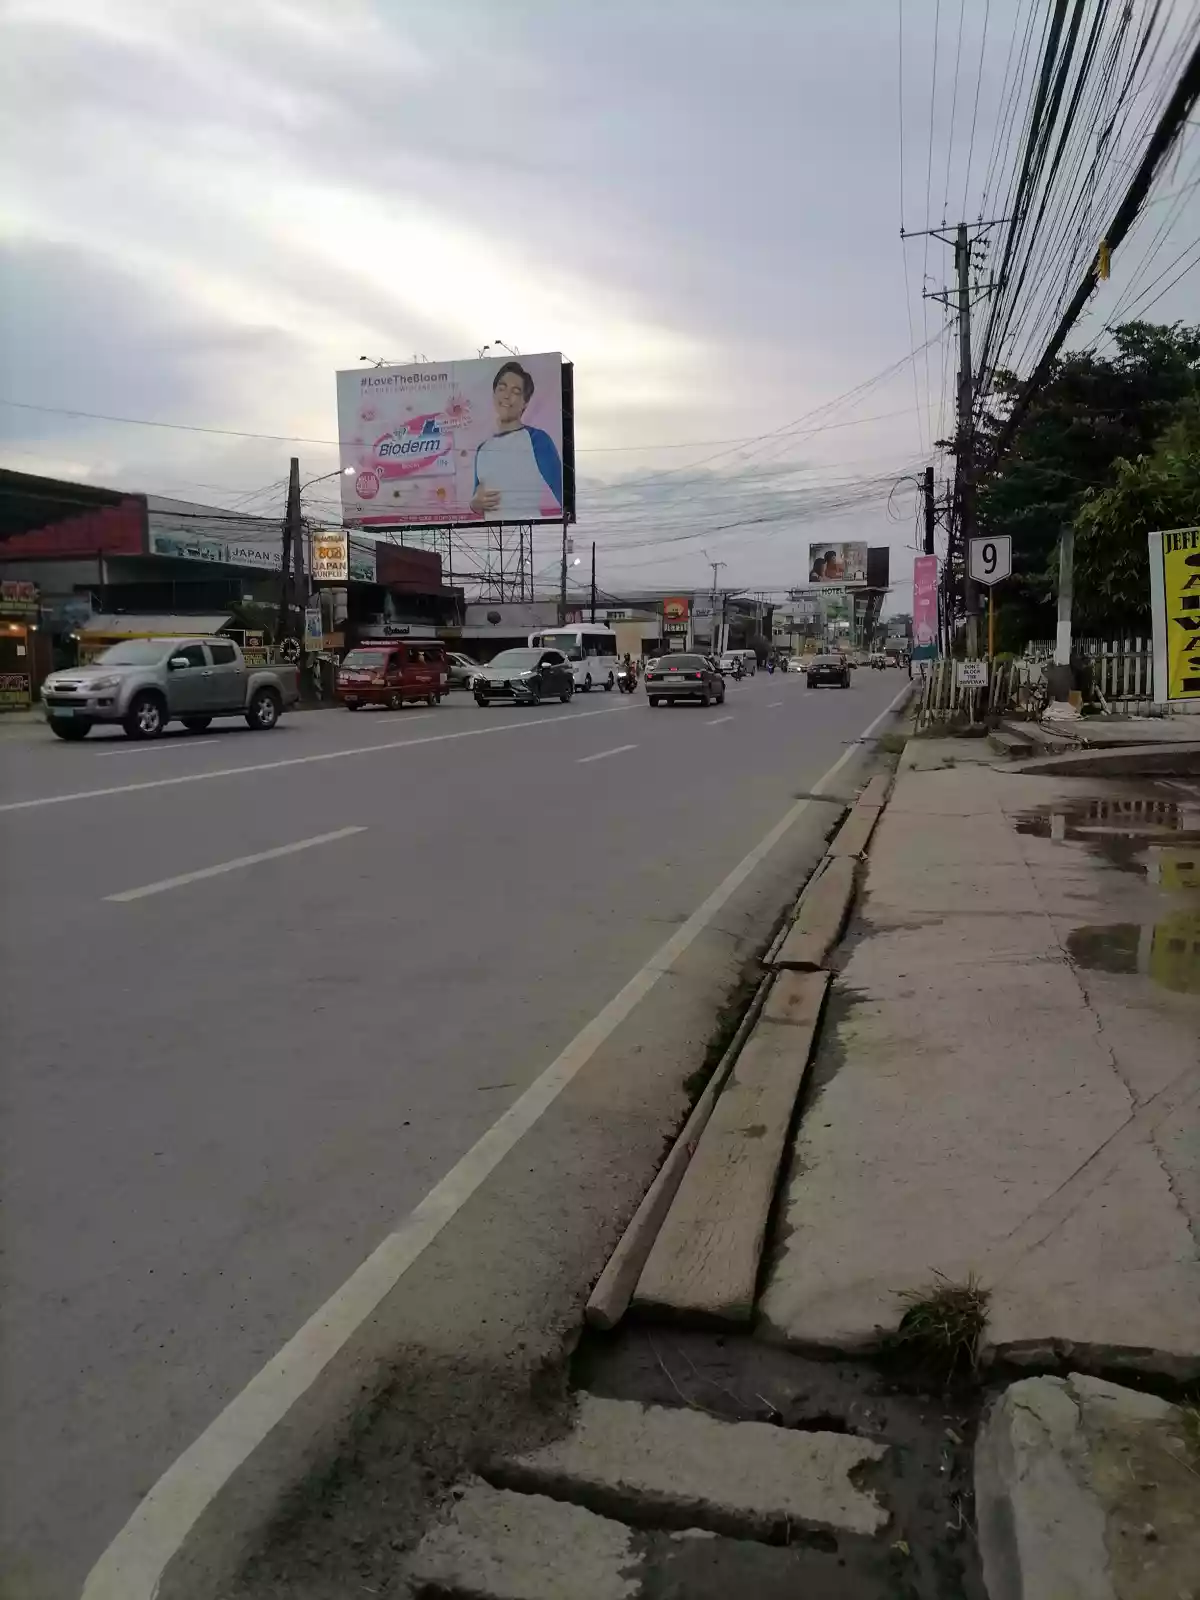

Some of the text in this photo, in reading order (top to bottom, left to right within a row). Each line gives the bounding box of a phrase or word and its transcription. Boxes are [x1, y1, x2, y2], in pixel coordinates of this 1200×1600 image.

[361, 373, 448, 387] #LoveTheBloom
[379, 439, 441, 457] Bioderm
[982, 543, 997, 574] 9
